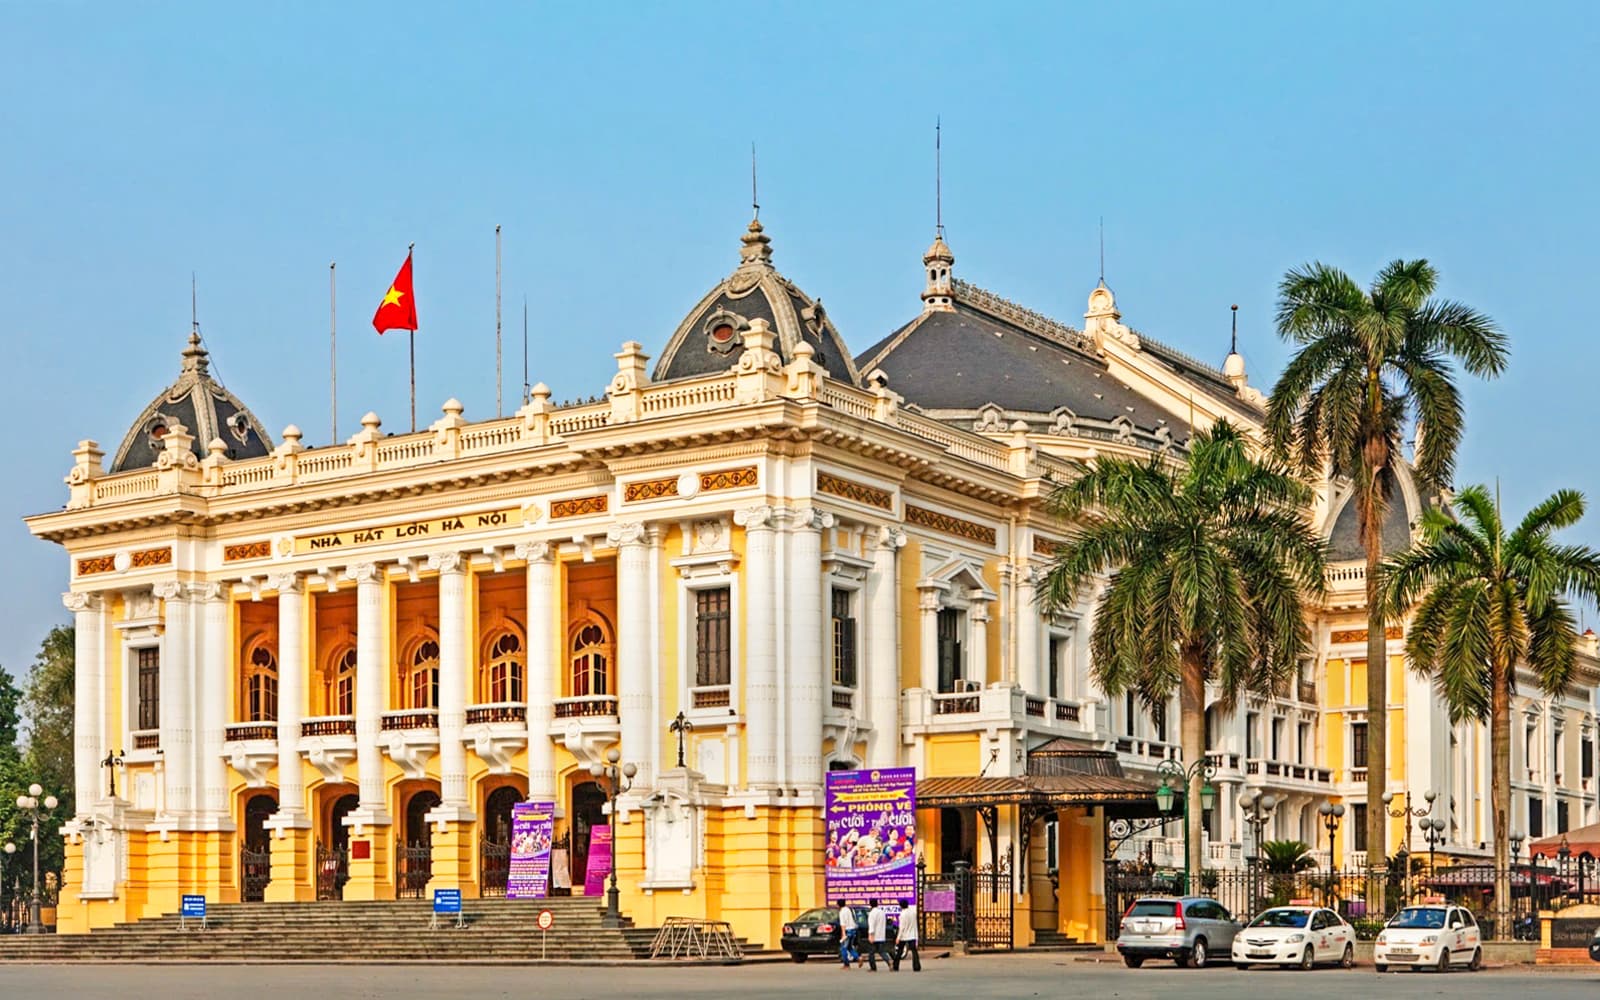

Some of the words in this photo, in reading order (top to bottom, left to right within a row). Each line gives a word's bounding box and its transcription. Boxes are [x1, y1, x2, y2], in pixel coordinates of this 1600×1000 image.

[310, 532, 342, 549] NHÀ
[353, 528, 384, 543] HÁT
[396, 522, 429, 537] LỚN
[442, 516, 464, 531] HÀ
[478, 510, 507, 526] NỘI
